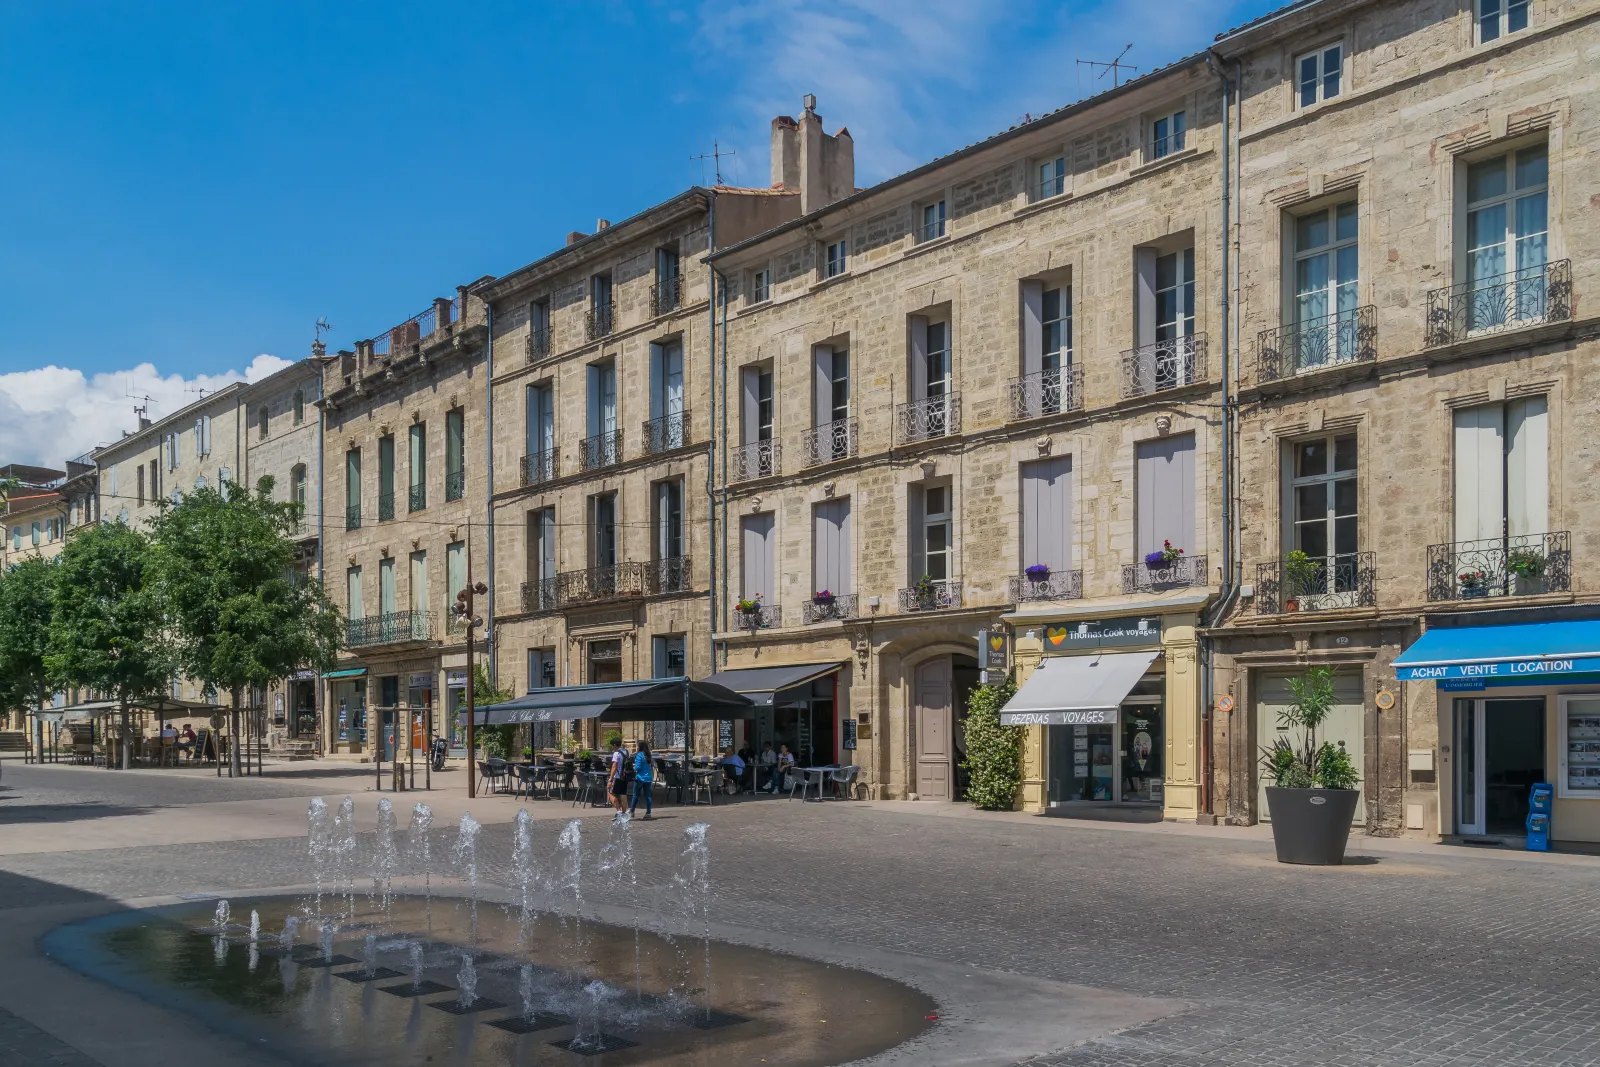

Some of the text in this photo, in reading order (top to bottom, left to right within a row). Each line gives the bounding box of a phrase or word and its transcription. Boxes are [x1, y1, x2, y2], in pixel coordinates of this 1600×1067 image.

[1069, 627, 1157, 640] Thomas Cook voyages
[1411, 660, 1573, 678] ACHAT VENTE LOCATION
[1010, 711, 1105, 724] PEZENAS VOYAGES
